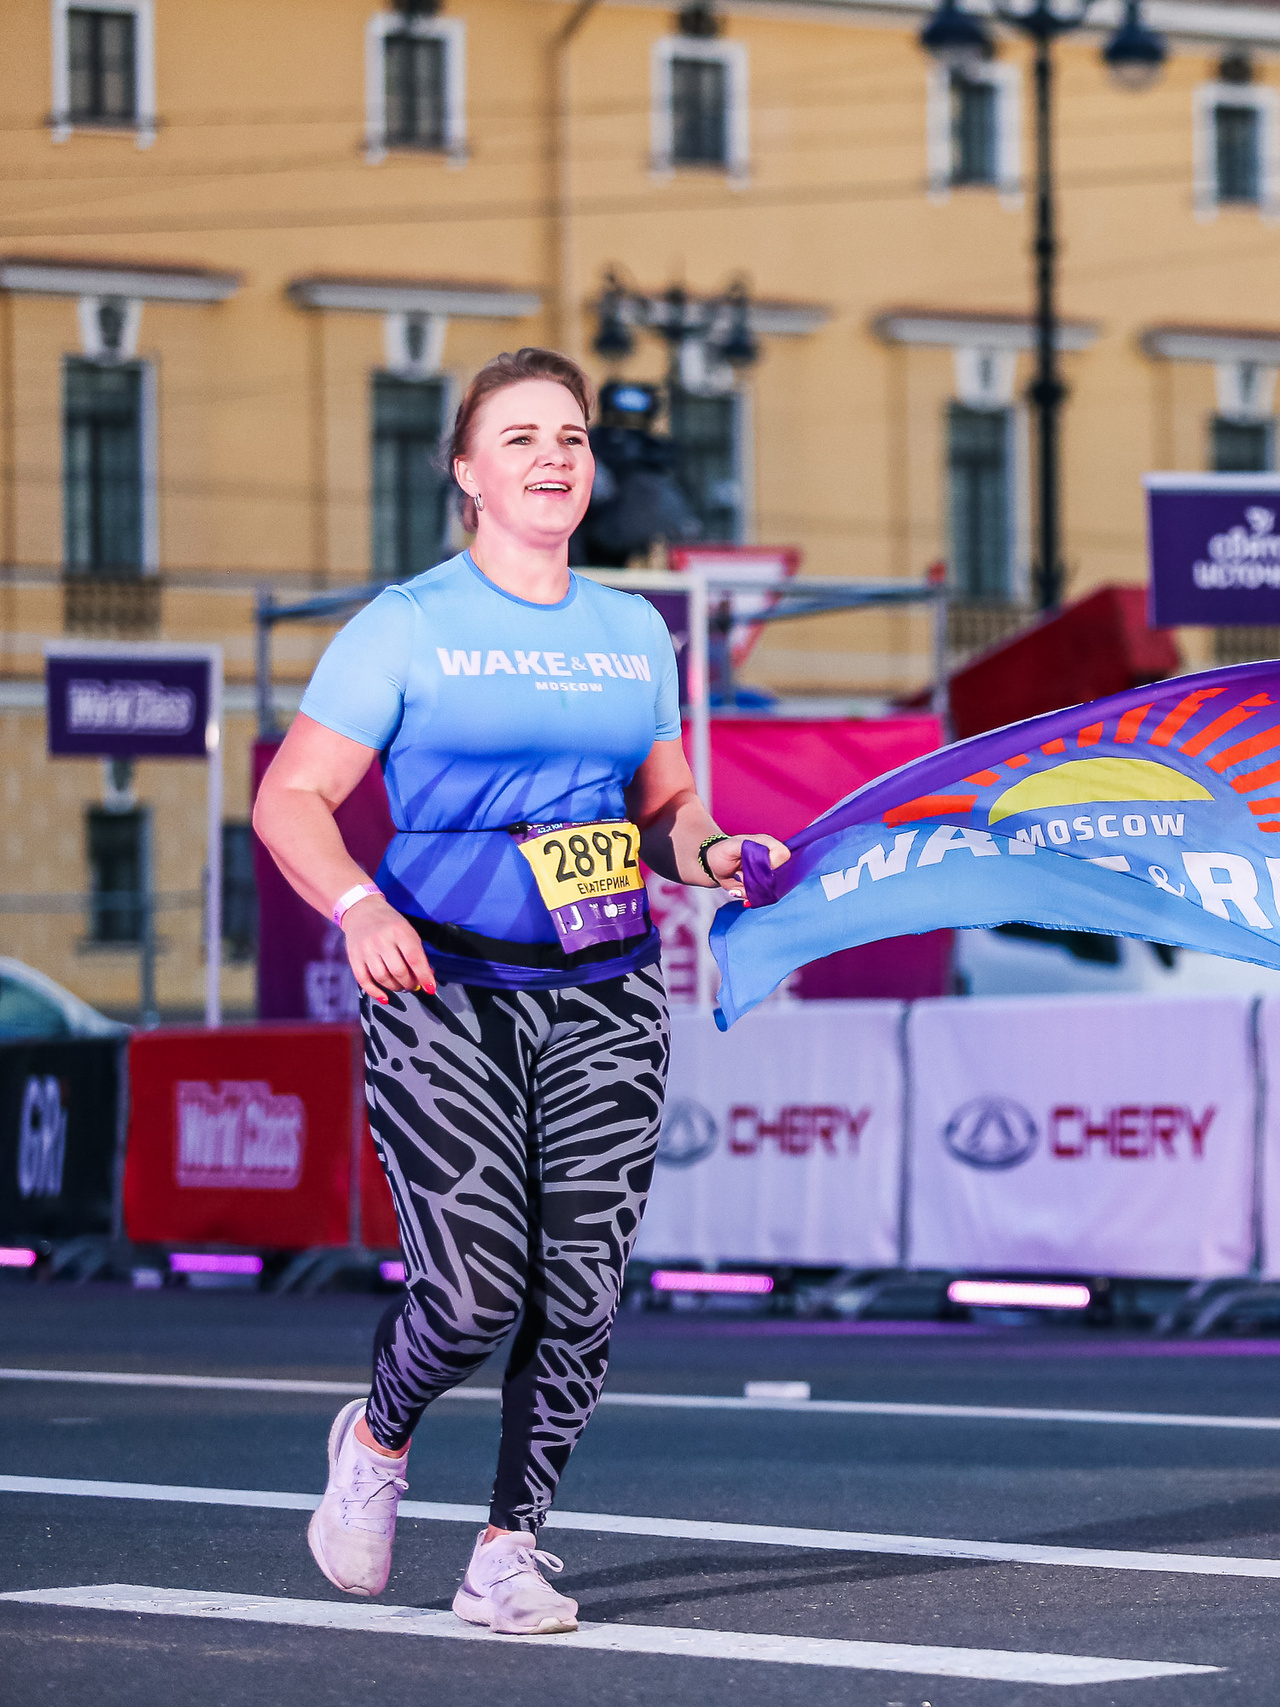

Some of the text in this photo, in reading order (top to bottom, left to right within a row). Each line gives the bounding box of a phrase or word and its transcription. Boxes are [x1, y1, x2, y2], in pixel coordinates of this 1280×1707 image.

[535, 681, 603, 692] MOSCOW
[1014, 813, 1184, 846] MOSCOW
[543, 831, 637, 883] 2892
[577, 875, 631, 895] ЕКАТЕРИНА
[727, 1105, 871, 1157] CHERY
[1050, 1105, 1216, 1158] CHERY
